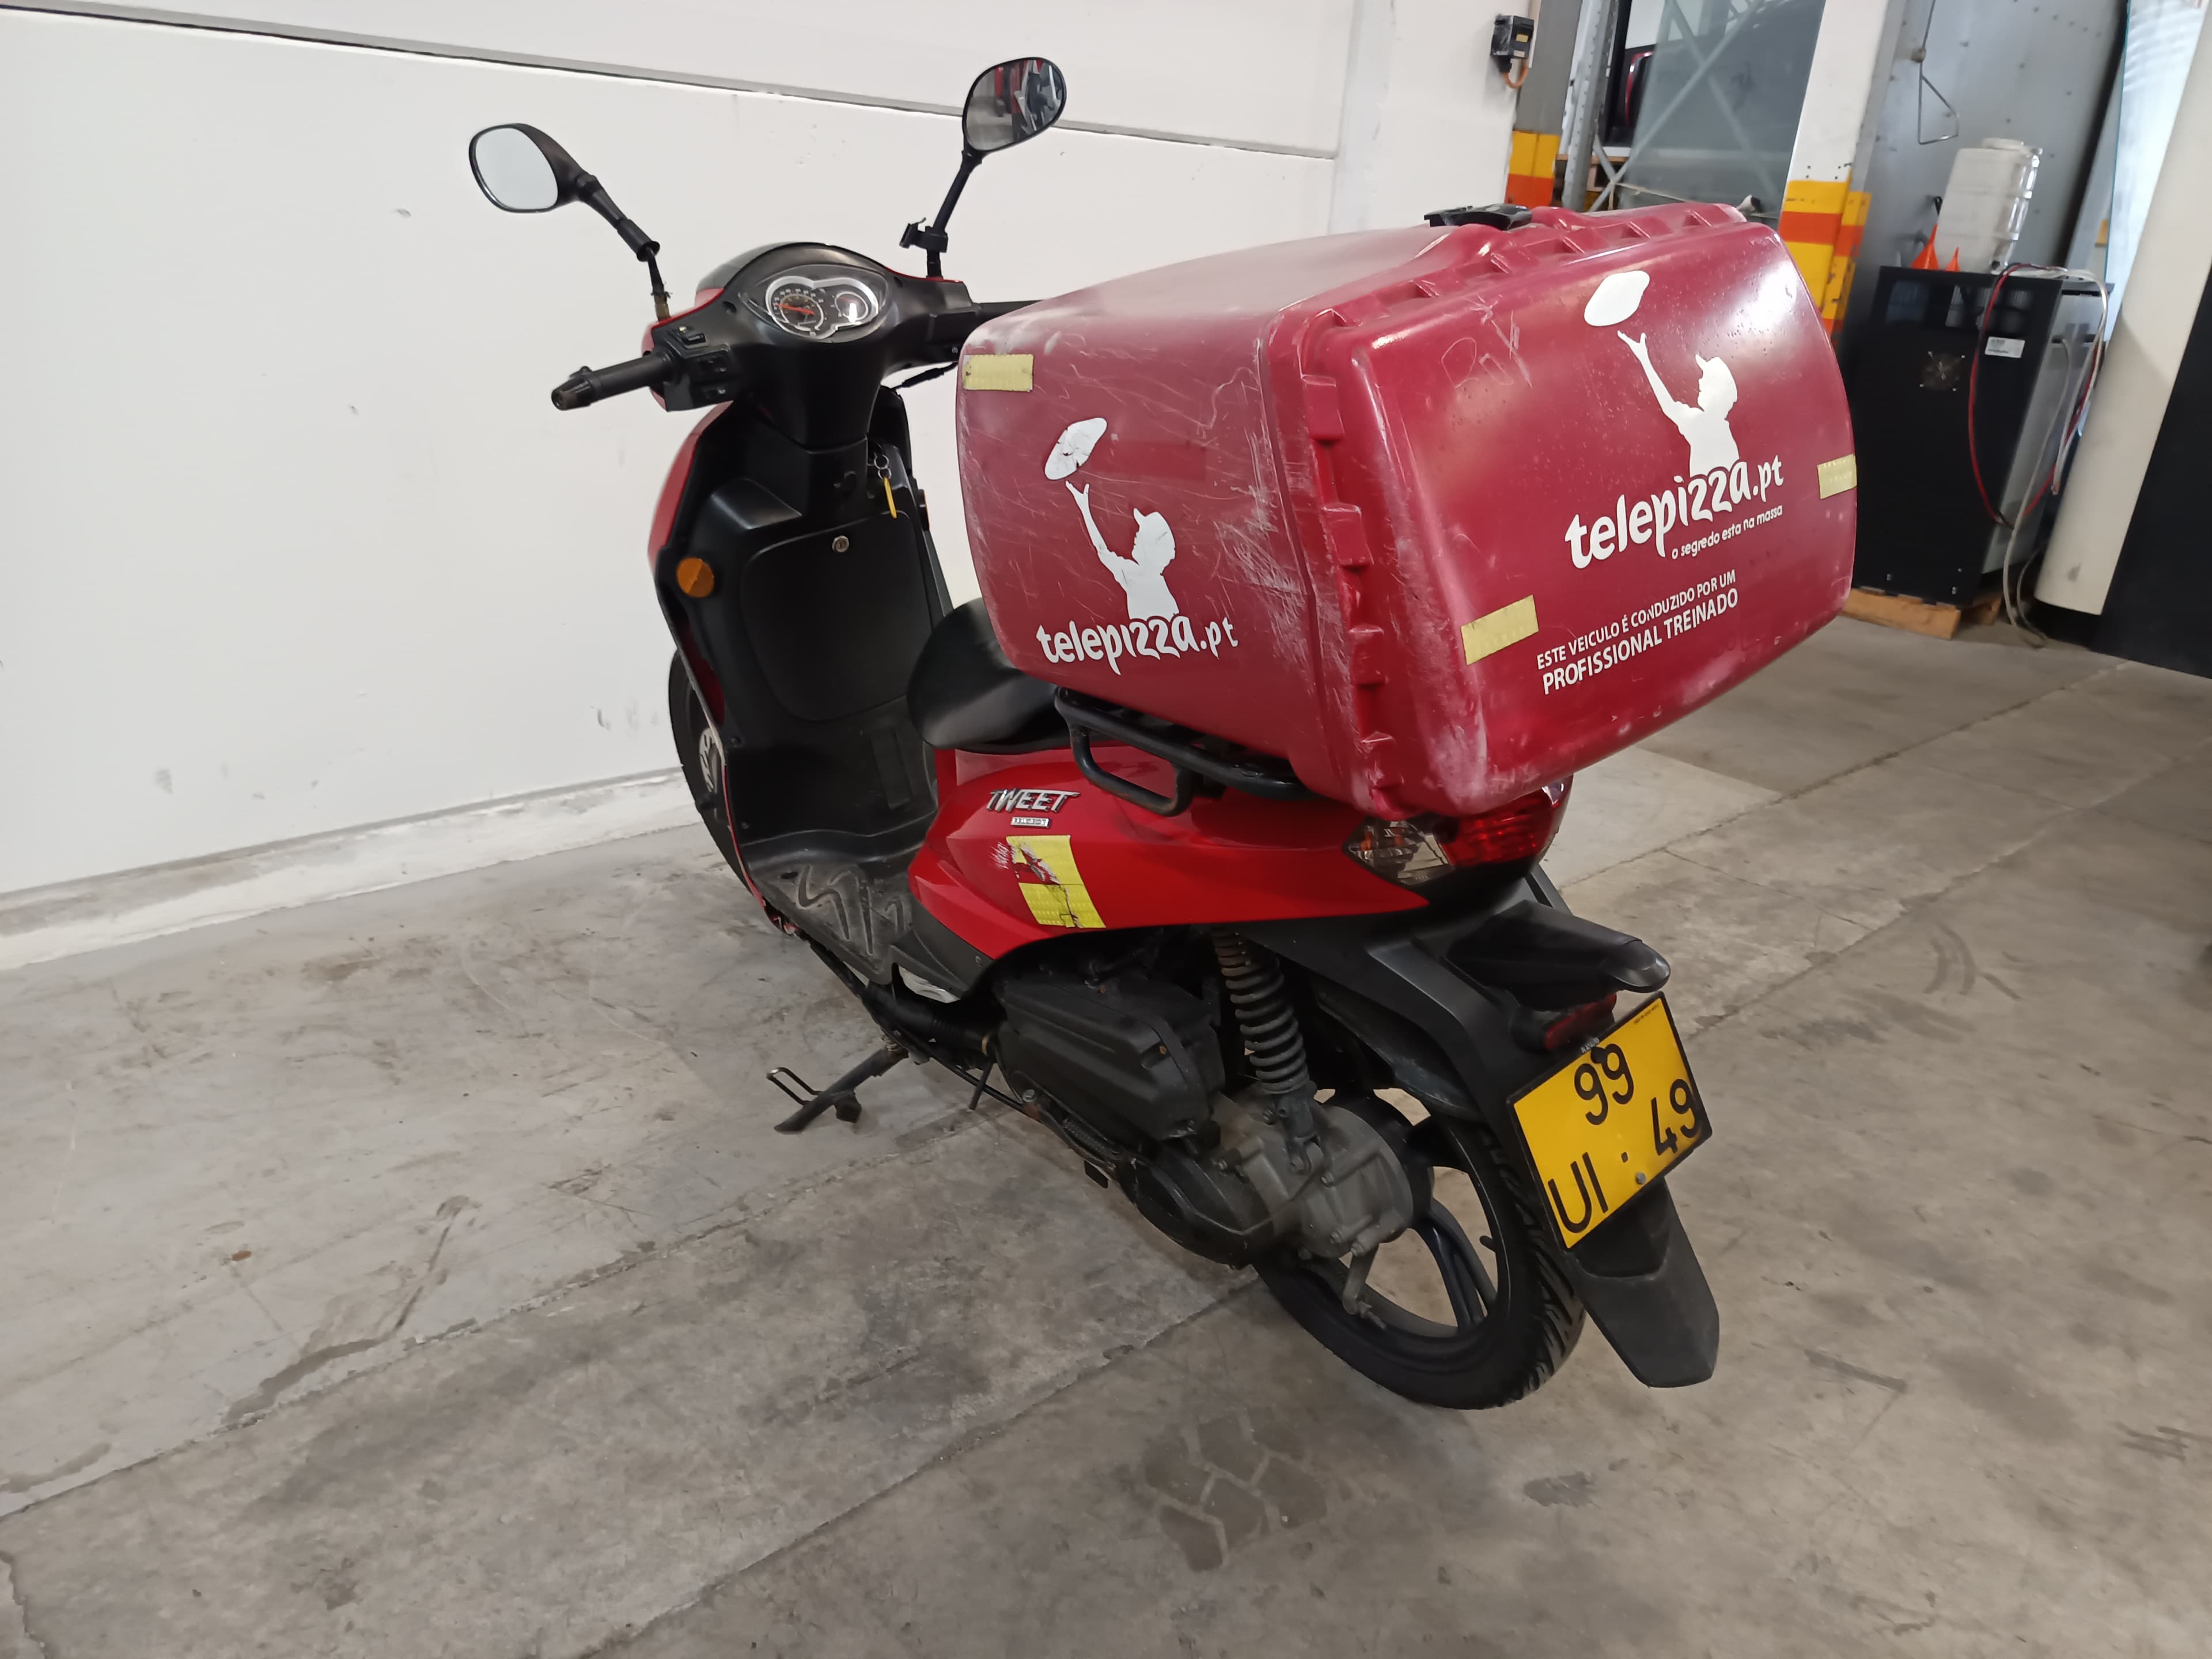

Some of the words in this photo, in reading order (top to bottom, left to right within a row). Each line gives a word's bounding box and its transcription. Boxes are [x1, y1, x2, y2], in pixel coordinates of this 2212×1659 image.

[1565, 455, 1784, 569] telepizza.pt
[1672, 548, 1679, 560] o
[1681, 531, 1720, 557] segredo
[1721, 524, 1741, 540] esta
[1743, 517, 1755, 531] na
[1757, 505, 1783, 526] massa
[1036, 616, 1238, 675] telepizza.pt
[1537, 647, 1567, 670] ESTE
[1568, 622, 1619, 656] VEICULO
[1622, 614, 1630, 632] É
[1631, 588, 1695, 628] CONDUZIDO
[1697, 579, 1718, 599] POR
[1719, 569, 1736, 589] UM
[1543, 628, 1662, 695] PROFISSIONAL
[1663, 588, 1738, 639] TREINADO
[986, 787, 1081, 813] TWEET
[1574, 1043, 1634, 1126] 99
